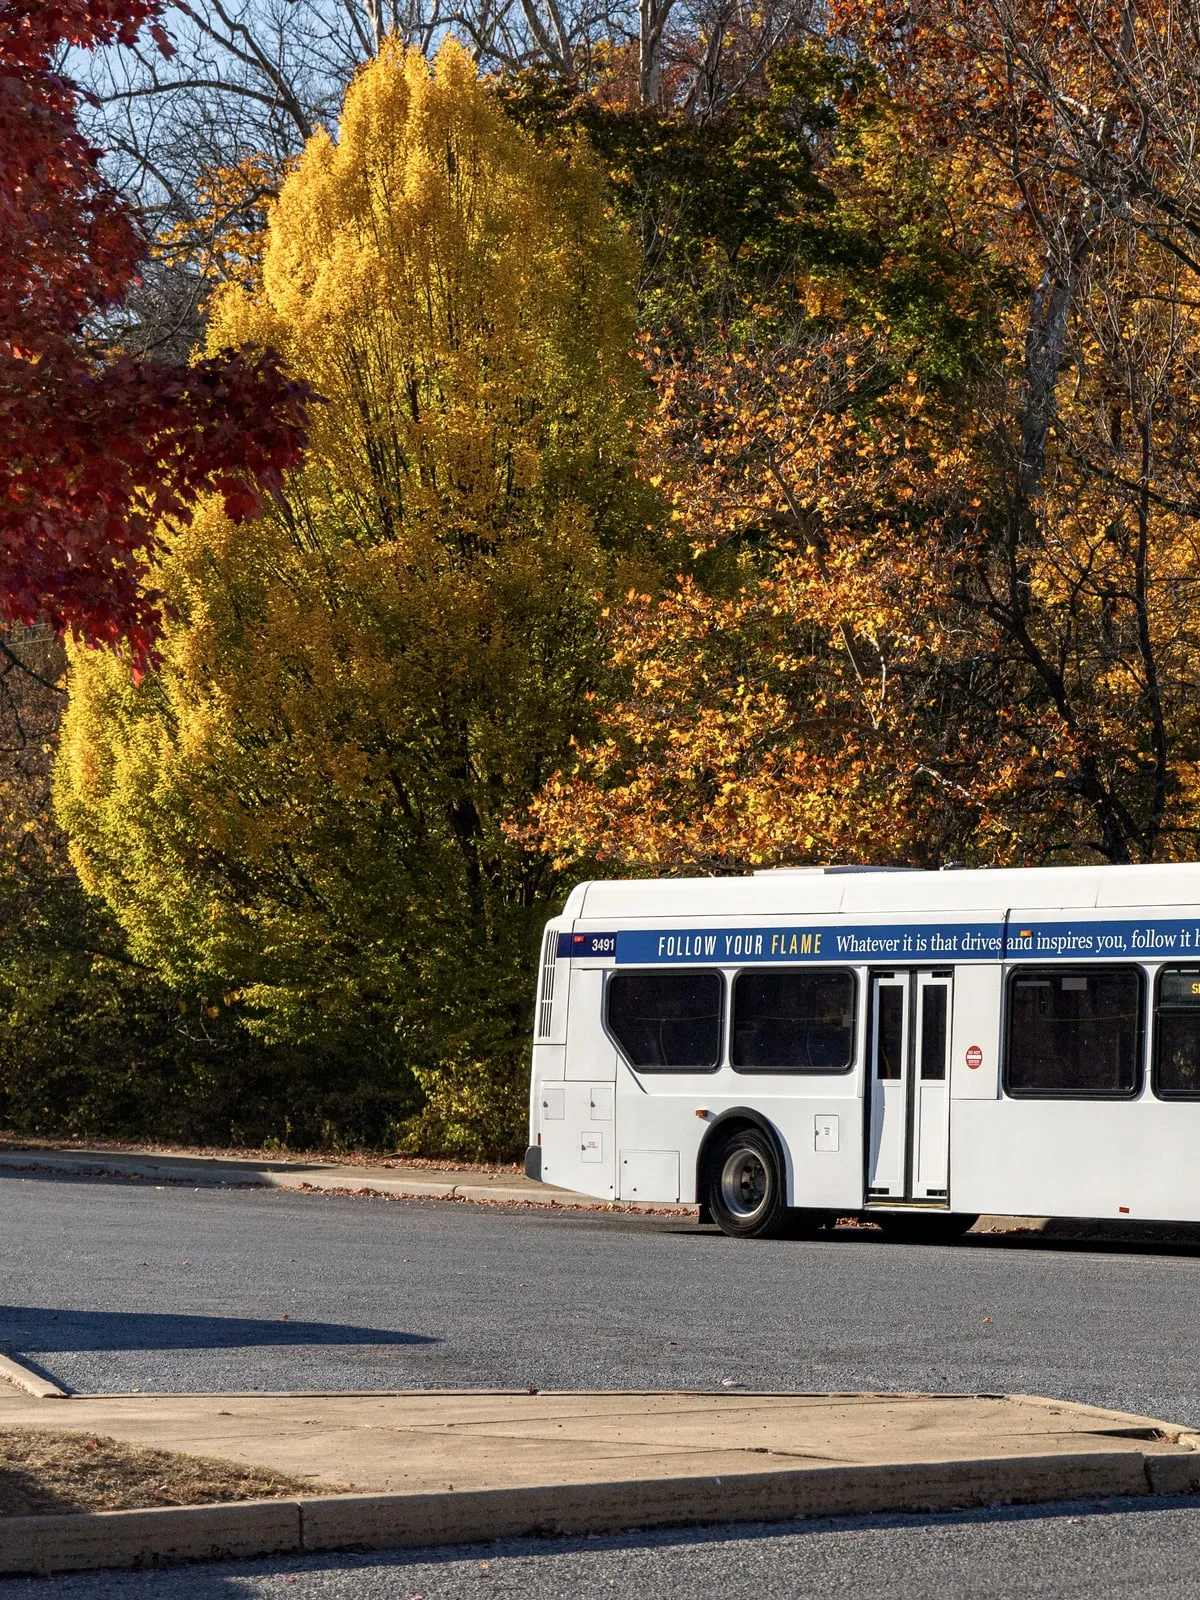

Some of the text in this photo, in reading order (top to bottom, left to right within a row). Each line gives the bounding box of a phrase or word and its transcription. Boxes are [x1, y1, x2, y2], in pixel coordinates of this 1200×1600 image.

[591, 938, 615, 951] 3491
[658, 936, 717, 957] FOLLOW
[725, 934, 763, 956] YOUR
[771, 933, 822, 955] FLAME
[836, 934, 900, 953] Whatever
[902, 934, 913, 951] it
[916, 934, 927, 951] is
[930, 933, 958, 951] that
[961, 932, 1002, 951] drives
[1006, 936, 1032, 950] and
[1036, 931, 1093, 955] inspires
[1095, 934, 1127, 953] you,
[1131, 929, 1177, 949] follow
[1179, 929, 1191, 948] it
